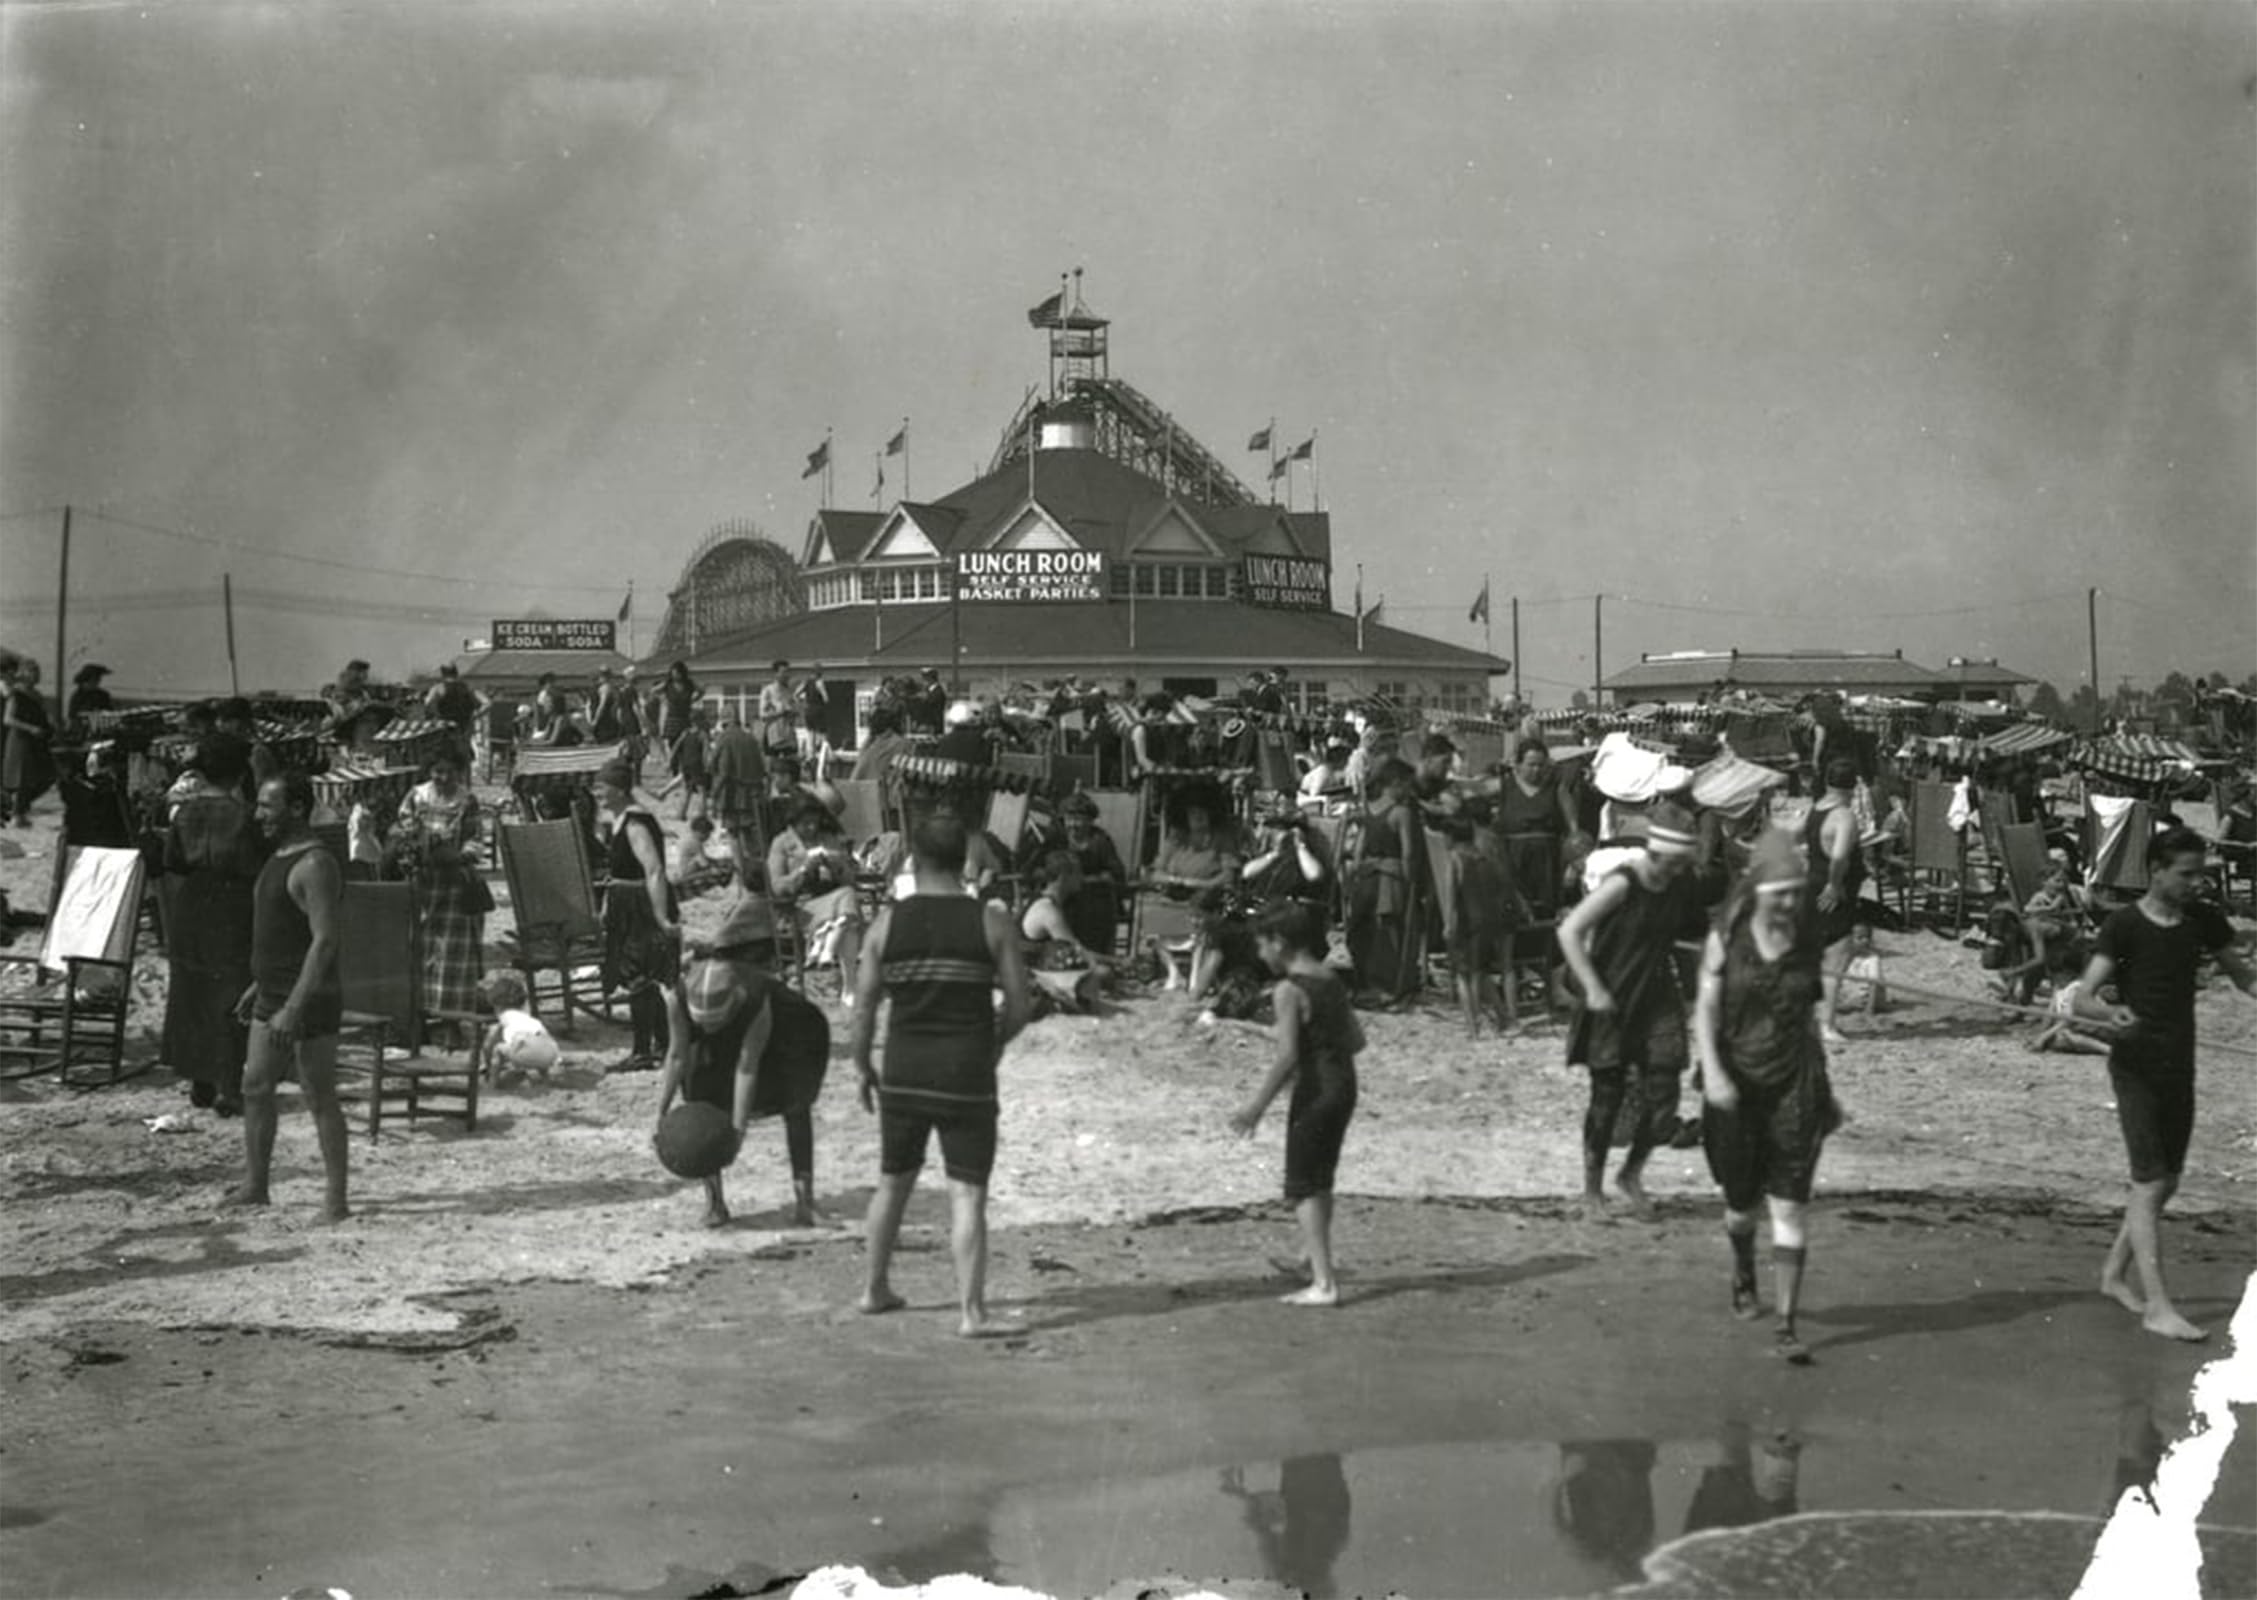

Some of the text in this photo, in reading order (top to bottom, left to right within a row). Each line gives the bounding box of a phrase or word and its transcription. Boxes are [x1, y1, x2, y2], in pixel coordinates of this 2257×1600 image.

[959, 552, 1101, 574] LUNCH ROOM
[970, 575, 1092, 585] SELF SERVICE
[1247, 557, 1325, 590] LUNCH ROOM
[959, 587, 1101, 600] BASKET PARTIES
